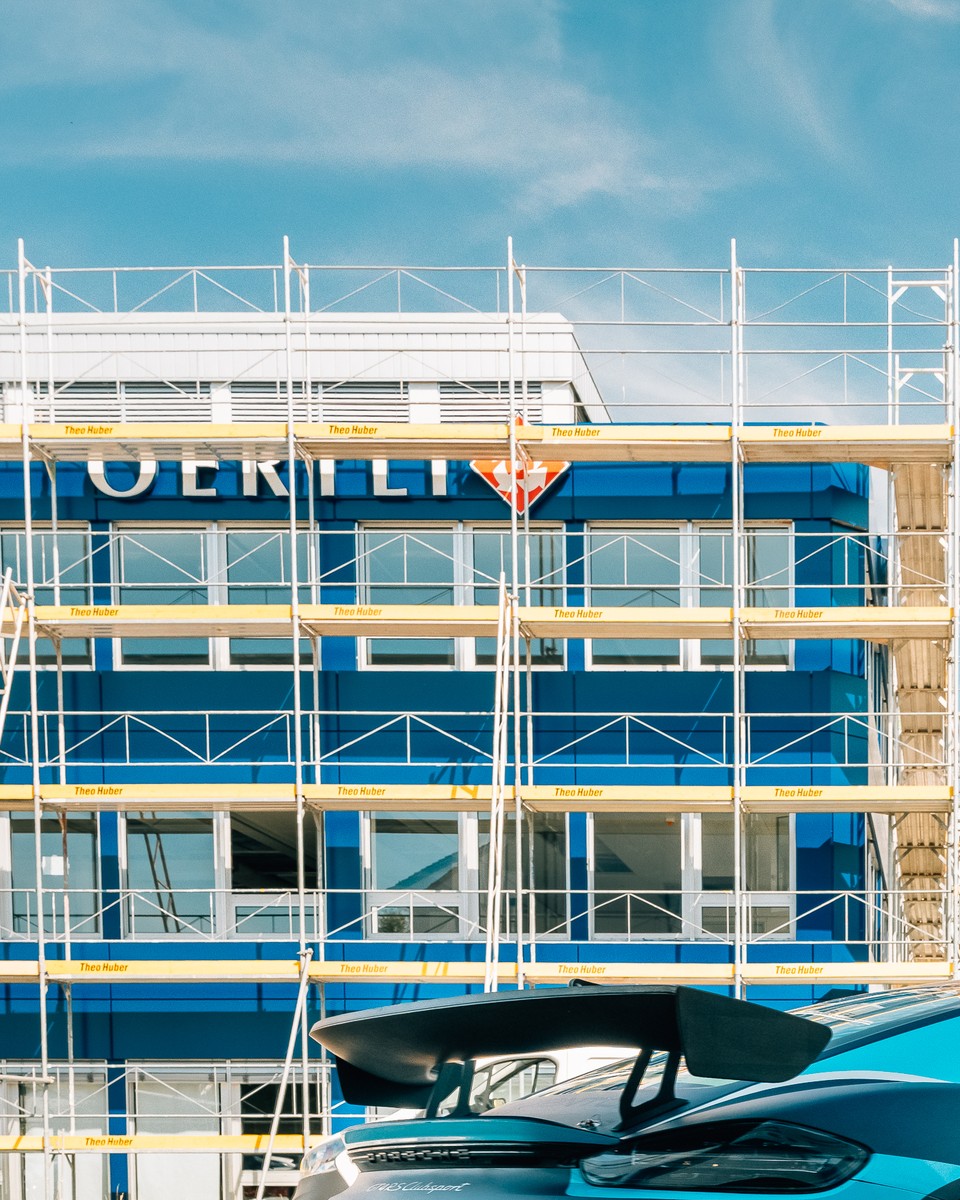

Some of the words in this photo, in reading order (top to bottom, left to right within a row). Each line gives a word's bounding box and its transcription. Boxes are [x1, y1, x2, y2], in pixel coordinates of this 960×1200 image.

[65, 425, 85, 435] Theo
[87, 425, 113, 435] Huber
[329, 425, 349, 435] Theo
[351, 425, 377, 435] Huber
[552, 427, 572, 437] Theo
[574, 427, 600, 437] Huber
[773, 428, 793, 437] Theo
[795, 428, 822, 437] Huber
[70, 607, 90, 617] Theo
[92, 607, 118, 617] Huber
[334, 607, 354, 616] Theo
[356, 607, 382, 616] Huber
[554, 609, 574, 618] Theo
[576, 609, 603, 618] Huber
[775, 609, 795, 618] Theo
[797, 609, 823, 618] Huber
[75, 786, 95, 796] Theo
[97, 786, 122, 796] Huber
[338, 786, 358, 796] Theo
[360, 786, 385, 796] Huber
[555, 787, 575, 797] Theo
[577, 787, 603, 797] Huber
[775, 788, 795, 797] Theo
[797, 788, 822, 797] Huber
[80, 962, 100, 972] Theo
[102, 962, 128, 972] Huber
[341, 964, 361, 973] Theo
[363, 964, 388, 973] Huber
[558, 964, 578, 974] Theo
[580, 964, 606, 974] Huber
[775, 965, 795, 975] Theo
[797, 965, 823, 975] Huber
[85, 1137, 105, 1146] Theo
[107, 1137, 133, 1146] Huber
[367, 1147, 470, 1162] PORSCHE
